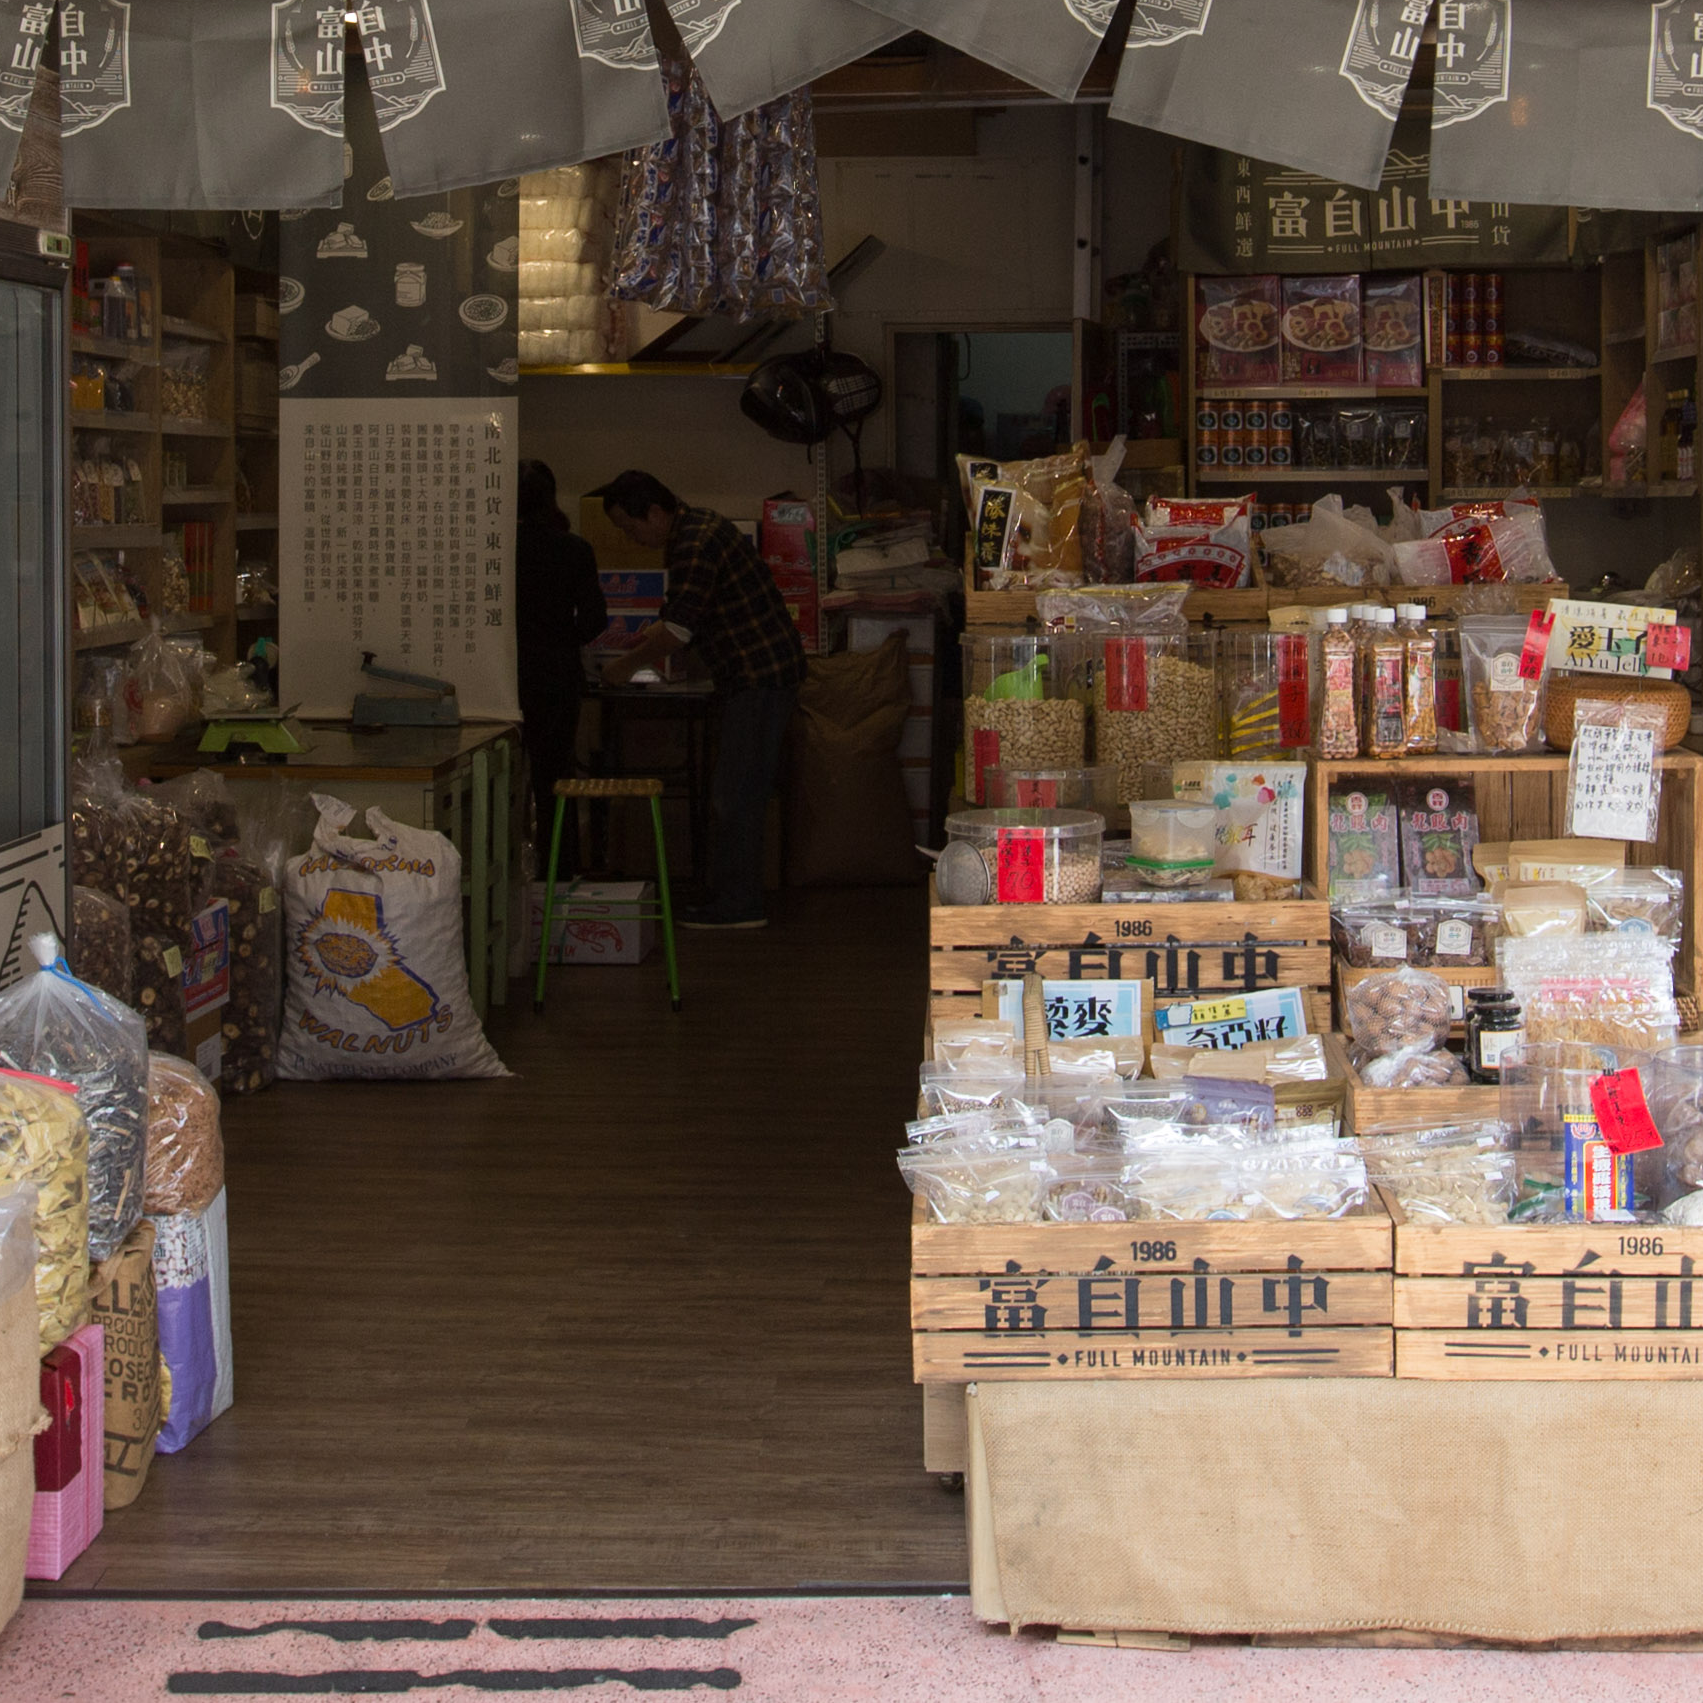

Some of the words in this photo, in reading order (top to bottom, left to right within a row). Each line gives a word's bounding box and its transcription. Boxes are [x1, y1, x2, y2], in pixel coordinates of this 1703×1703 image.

[1331, 812, 1389, 832] 龍眼肉
[1411, 811, 1469, 831] 龍眼肉
[1114, 920, 1153, 937] 1986
[1131, 1241, 1177, 1261] 1986
[1618, 1236, 1664, 1256] 1986
[979, 1254, 1330, 1338] 富自山中
[1076, 1350, 1121, 1367] FULL
[1133, 1349, 1230, 1367] MOUNTAIN
[1557, 1344, 1602, 1362] FULL
